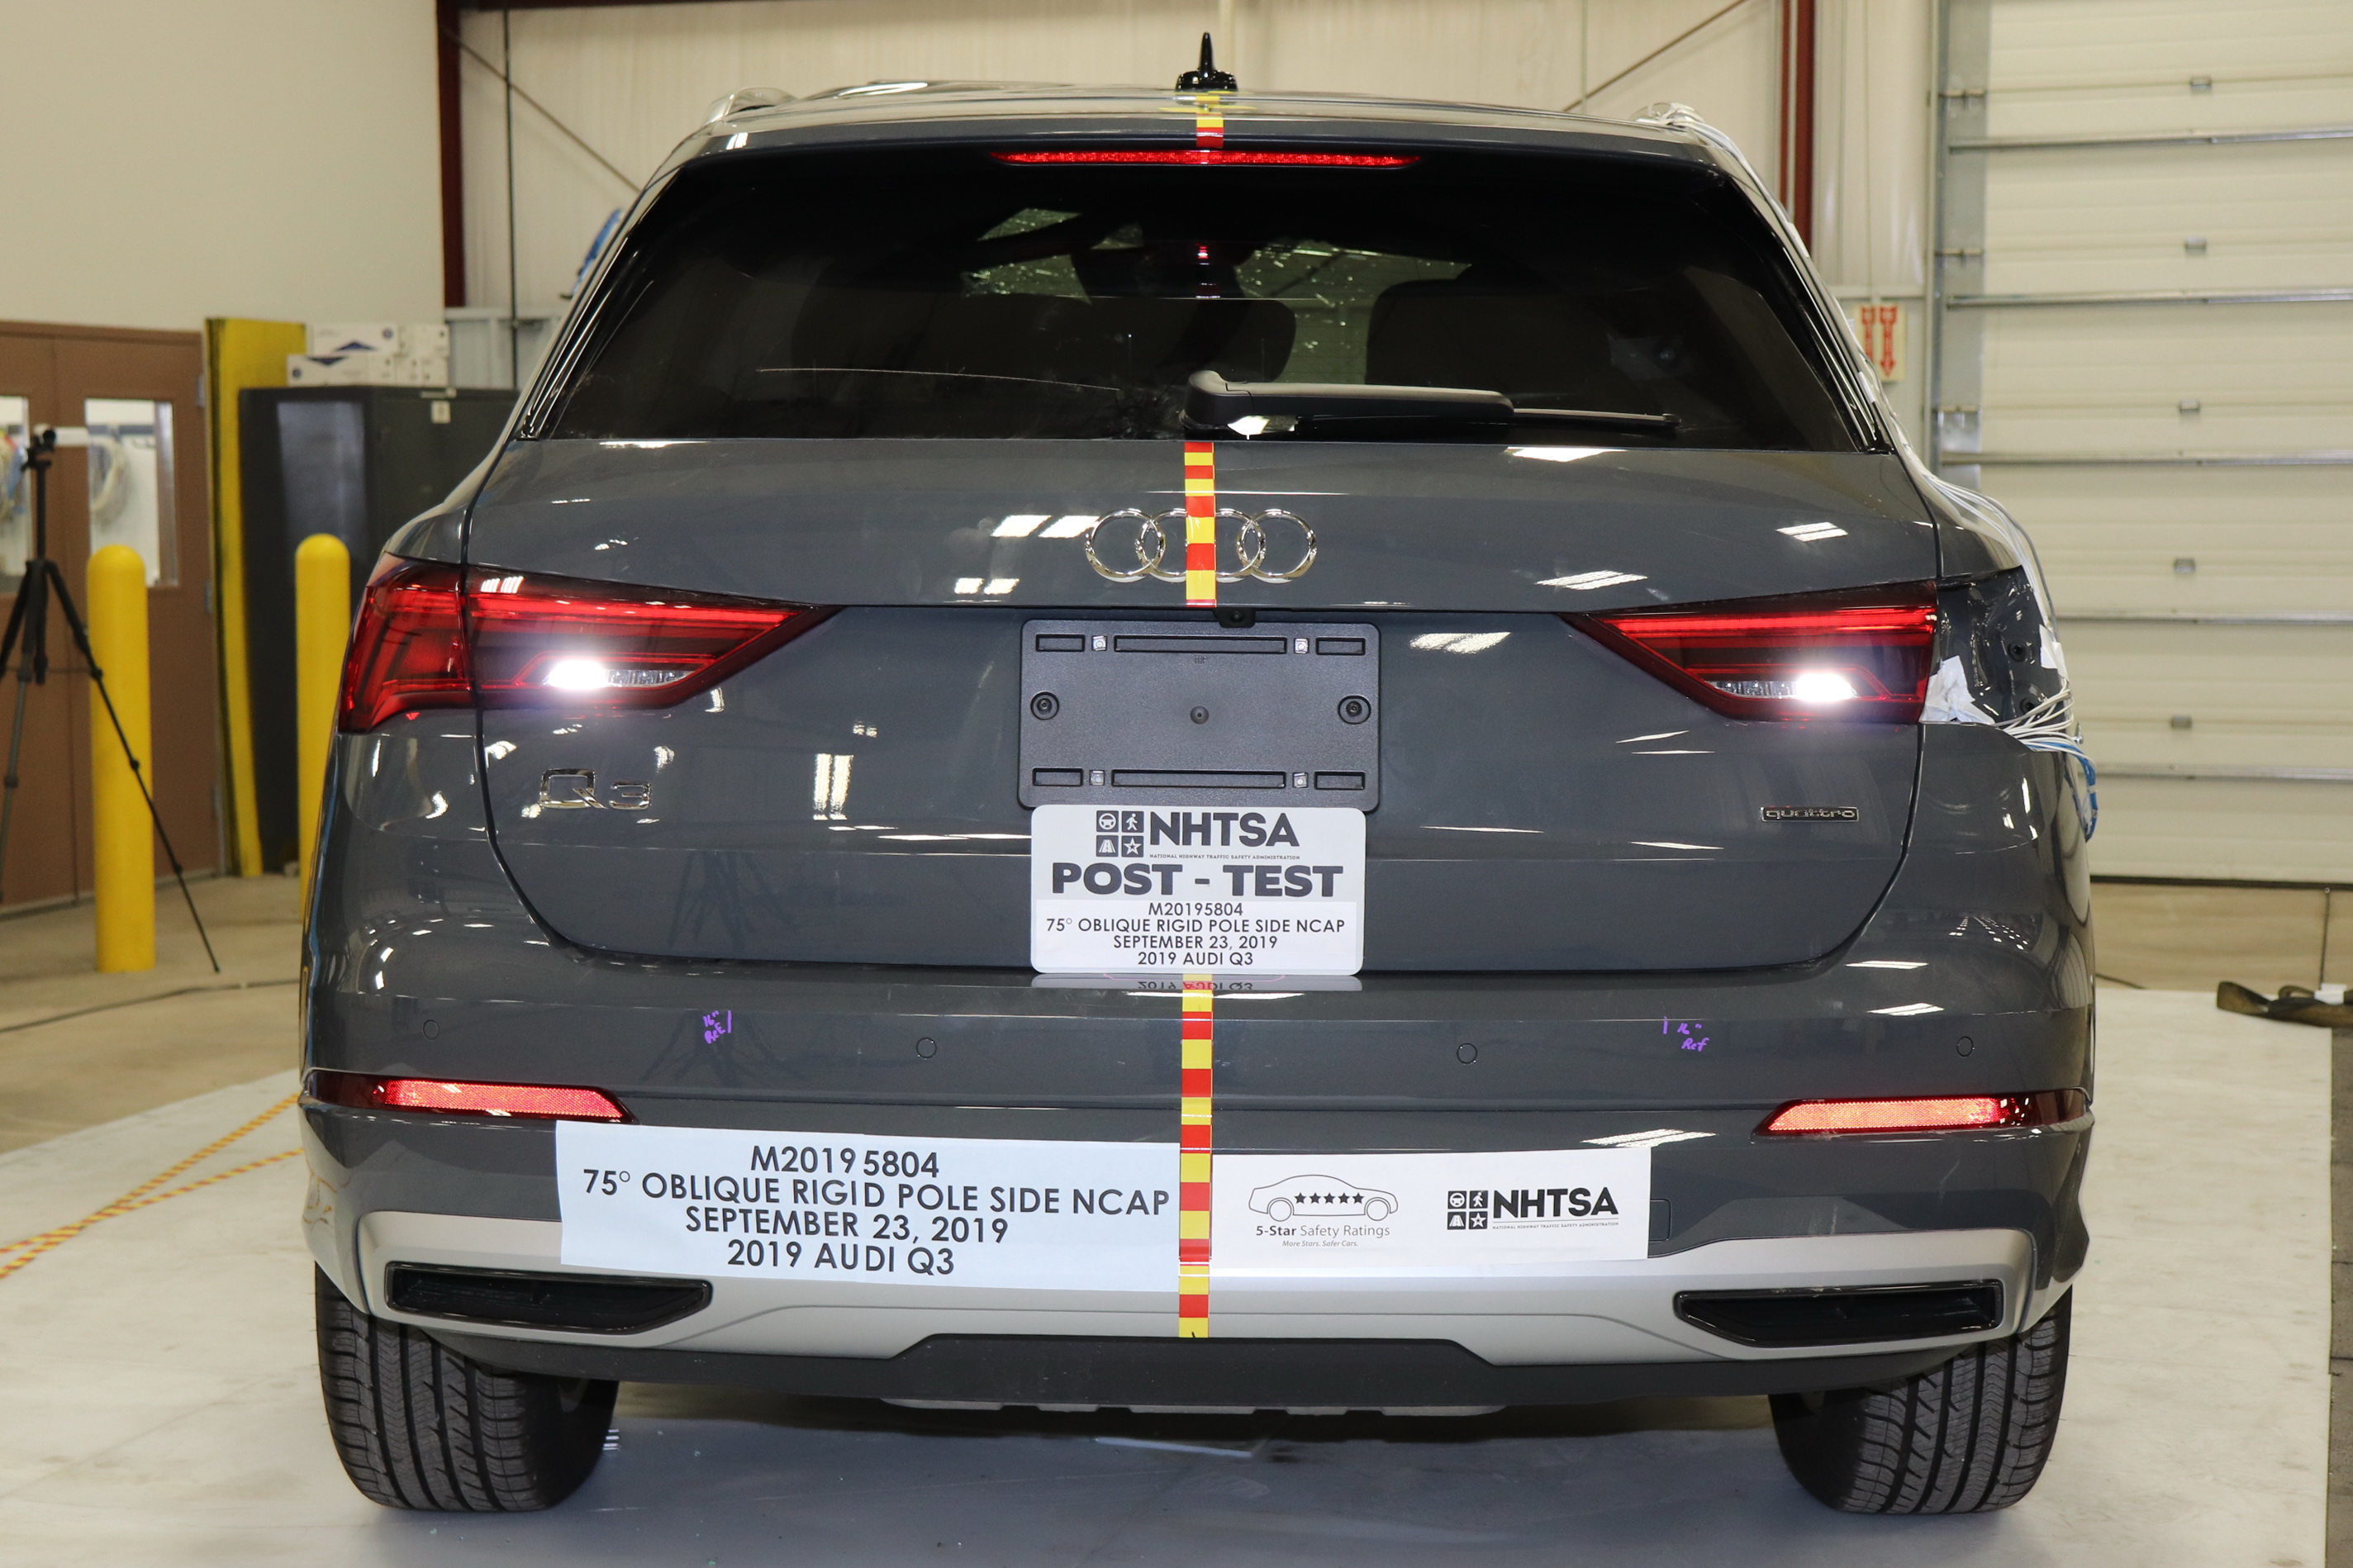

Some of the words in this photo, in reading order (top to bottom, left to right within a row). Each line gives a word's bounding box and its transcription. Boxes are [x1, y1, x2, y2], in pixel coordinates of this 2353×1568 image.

[539, 767, 653, 810] Q3
[1149, 811, 1300, 848] NHTSA
[1765, 808, 1856, 820] quattro
[1052, 862, 1183, 896] POST
[1222, 864, 1344, 897] TEST
[1077, 918, 1150, 933] OBLIQUE
[1157, 919, 1202, 933] RIGID
[1209, 919, 1250, 933] POLE
[1255, 919, 1291, 933] SIDE
[1296, 919, 1345, 933] NCAP
[1148, 902, 1243, 916] M20195804
[1113, 934, 1203, 949] SEPTEMBER
[1209, 935, 1233, 951] 23,
[1238, 935, 1278, 949] 2019
[1138, 951, 1176, 966] 2019
[1182, 952, 1224, 966] AUDI
[1229, 952, 1253, 967] Q3
[750, 1145, 939, 1178] M20195804
[641, 1171, 780, 1205] OBLIQUE
[792, 1178, 885, 1208] RIGID
[898, 1183, 978, 1212] POLE
[990, 1186, 1060, 1214] SIDE
[1072, 1188, 1170, 1216] NCAP
[1492, 1186, 1619, 1219] NHTSA
[685, 1205, 859, 1238] SEPTEMBER
[872, 1214, 919, 1244] 23,
[930, 1215, 1009, 1244] 2019
[1256, 1224, 1297, 1237] 5-Star
[1300, 1224, 1340, 1239] Safety
[1343, 1224, 1390, 1239] Ratings
[727, 1238, 802, 1268] 2019
[814, 1243, 895, 1272] AUDI
[907, 1247, 954, 1276] Q3
